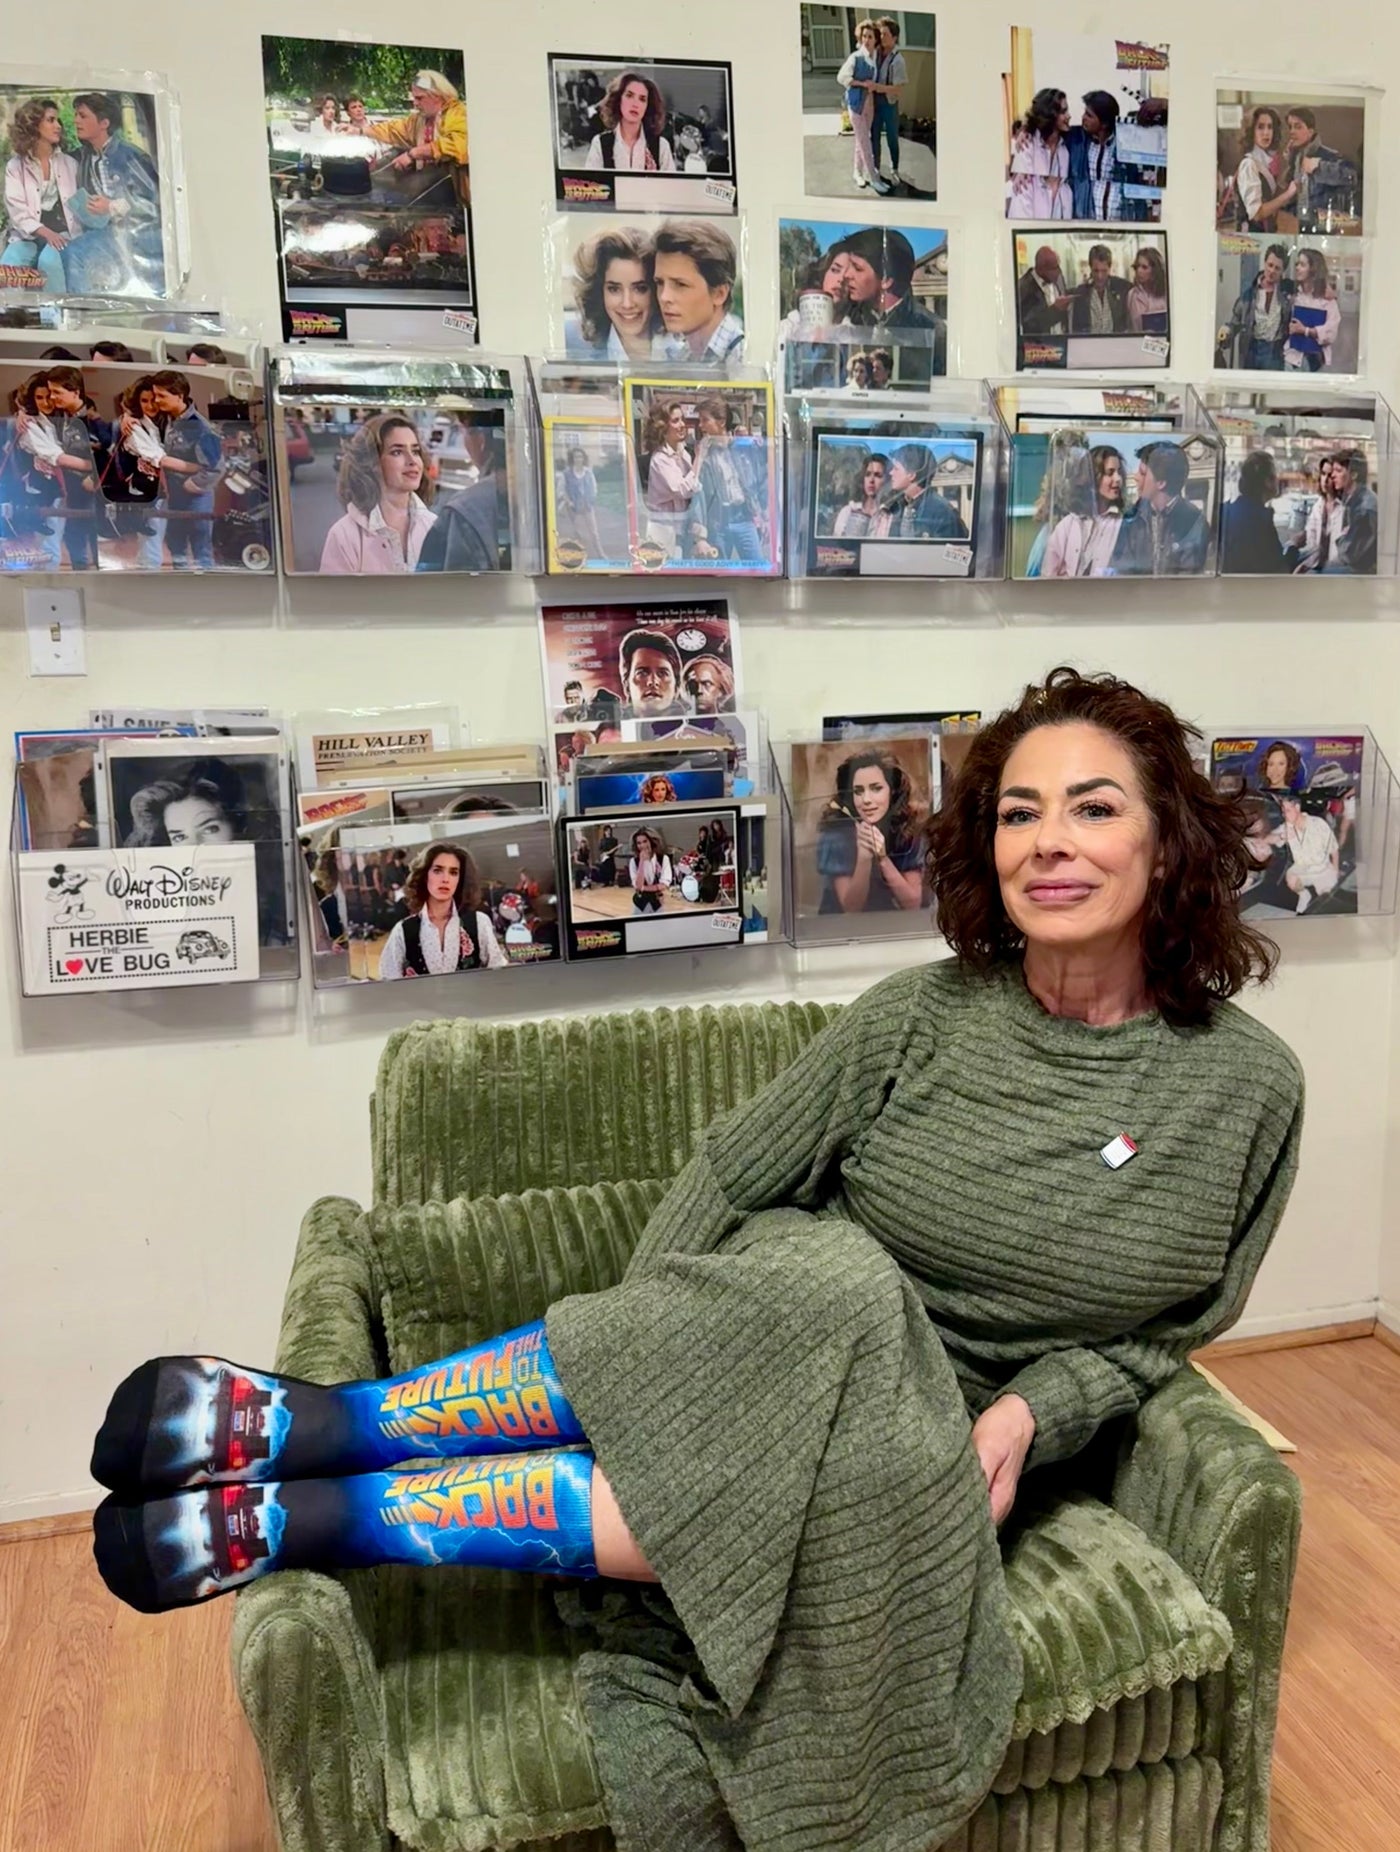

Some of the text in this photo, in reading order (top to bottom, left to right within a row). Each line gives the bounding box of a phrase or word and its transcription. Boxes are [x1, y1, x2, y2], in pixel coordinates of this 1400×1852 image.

[318, 733, 429, 751] HILL VALLEY
[318, 746, 428, 760] PRESERVATION SOCIETY
[125, 894, 216, 911] PRODUCTIONS
[70, 927, 150, 948] HERBIE
[101, 946, 121, 955] THE
[123, 952, 171, 972] BUG
[512, 1329, 544, 1356] THE
[380, 1341, 515, 1412] FUTURE
[517, 1353, 543, 1384] TO
[408, 1384, 560, 1437] BACK
[385, 1456, 531, 1498] FUTURE
[411, 1466, 559, 1531] BACK
